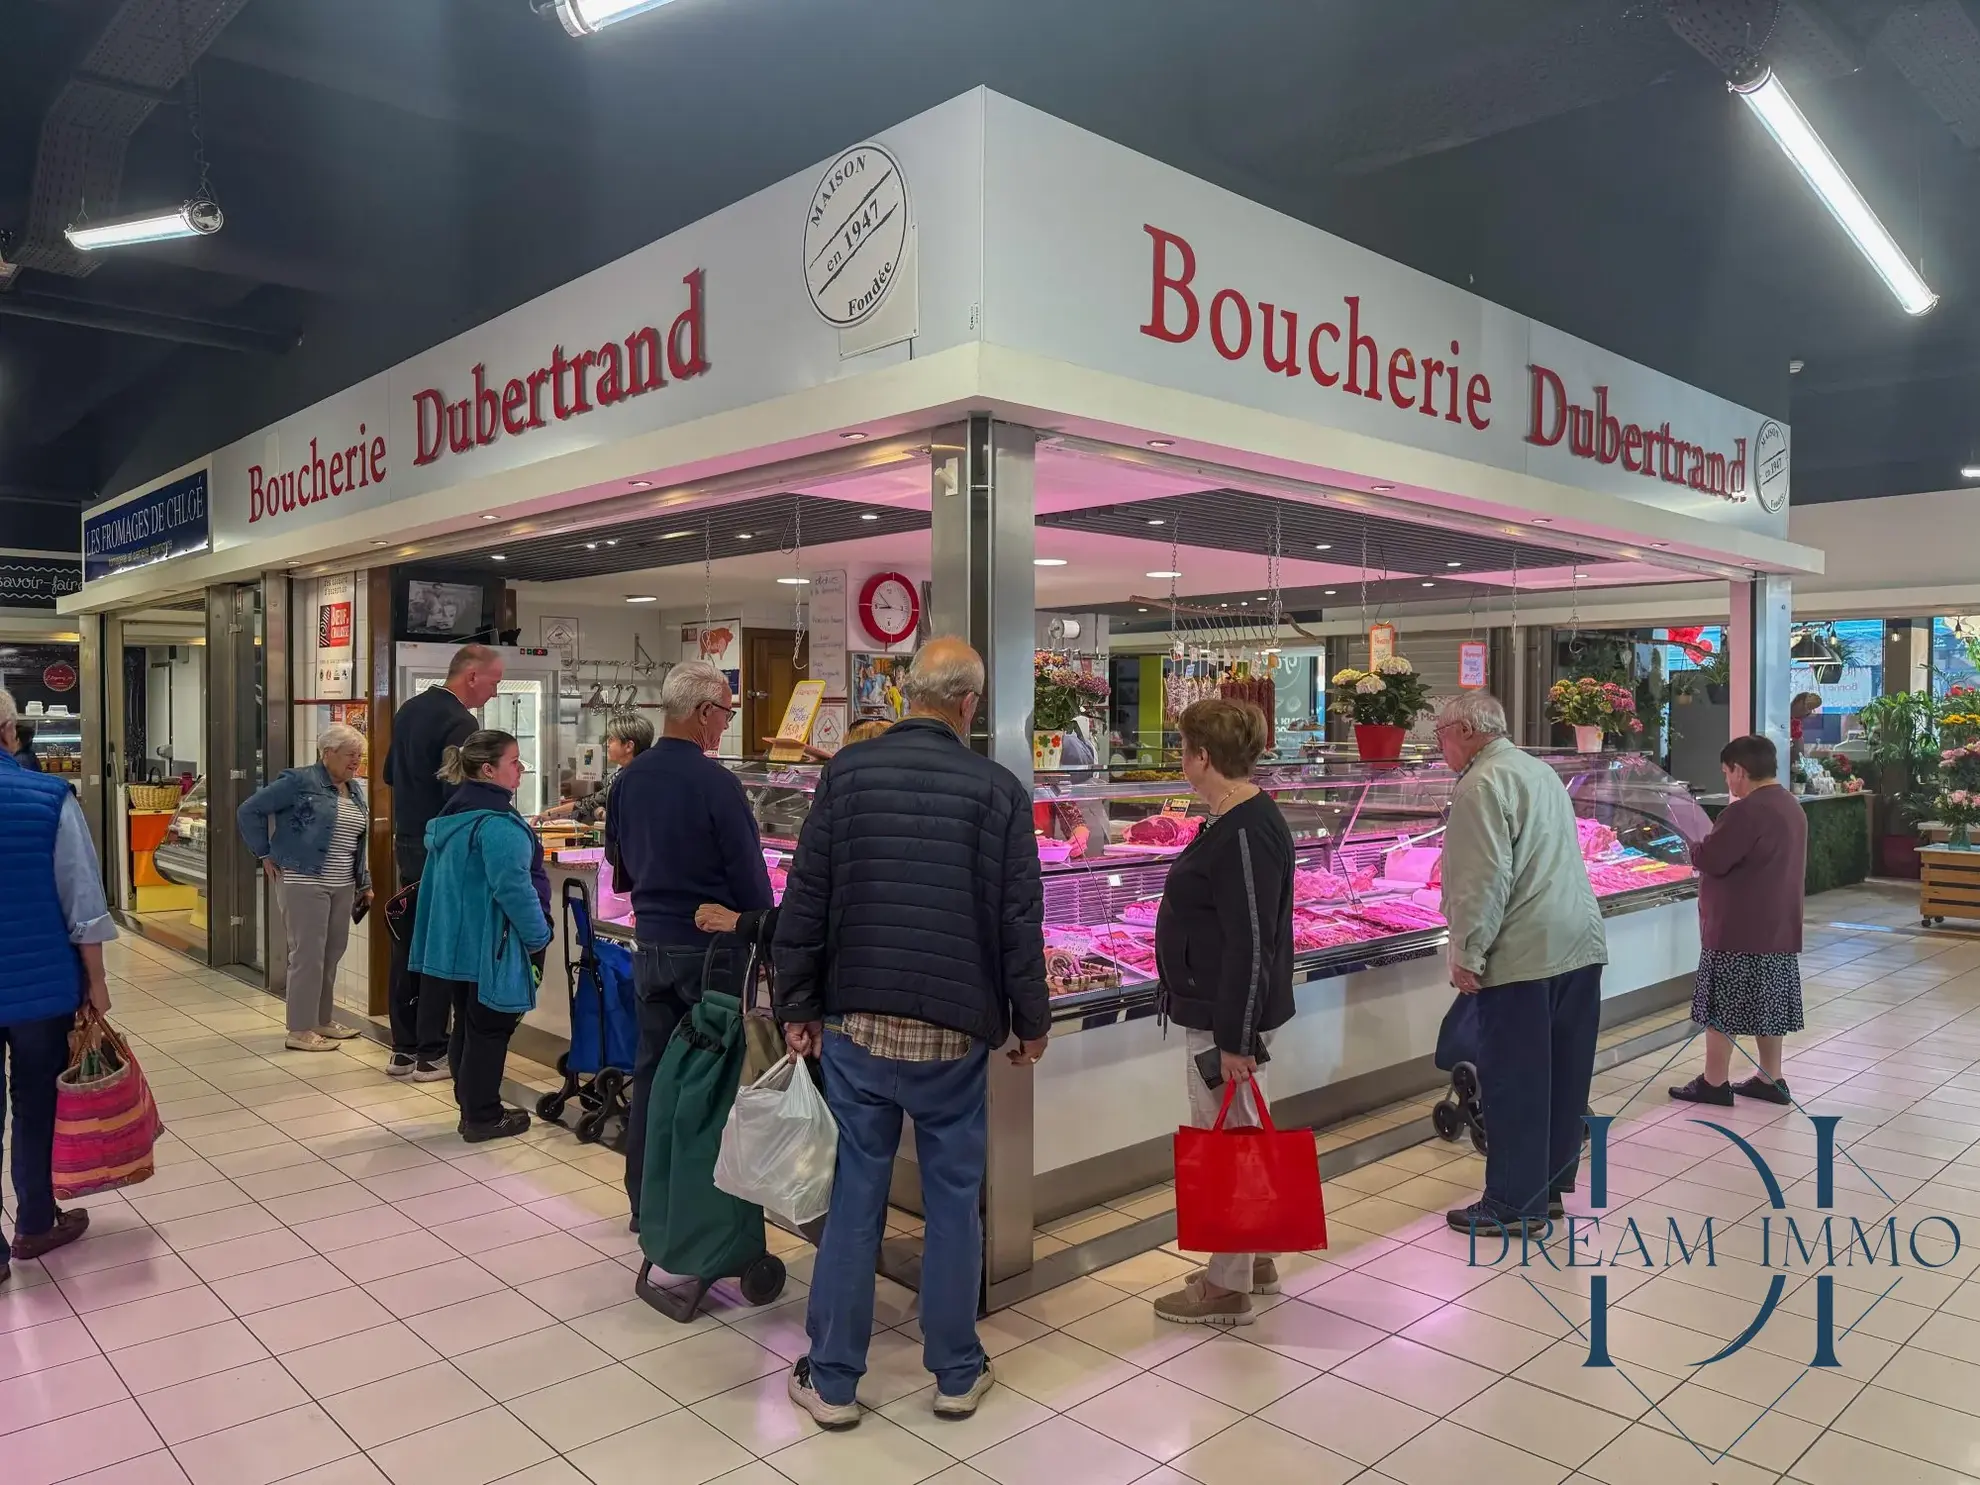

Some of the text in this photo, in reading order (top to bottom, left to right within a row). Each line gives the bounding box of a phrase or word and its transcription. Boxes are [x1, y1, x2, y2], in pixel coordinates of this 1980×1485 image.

[811, 155, 867, 228] MAISON
[826, 198, 880, 272] en 1947
[847, 260, 892, 317] Fondée
[248, 266, 709, 523] Boucherie Dubertrand
[1139, 223, 1748, 502] Boucherie Dubertrand
[86, 527, 100, 557] LES
[101, 508, 149, 552] FROMAGES
[151, 502, 164, 535] DE
[166, 476, 204, 529] CHLOÉ
